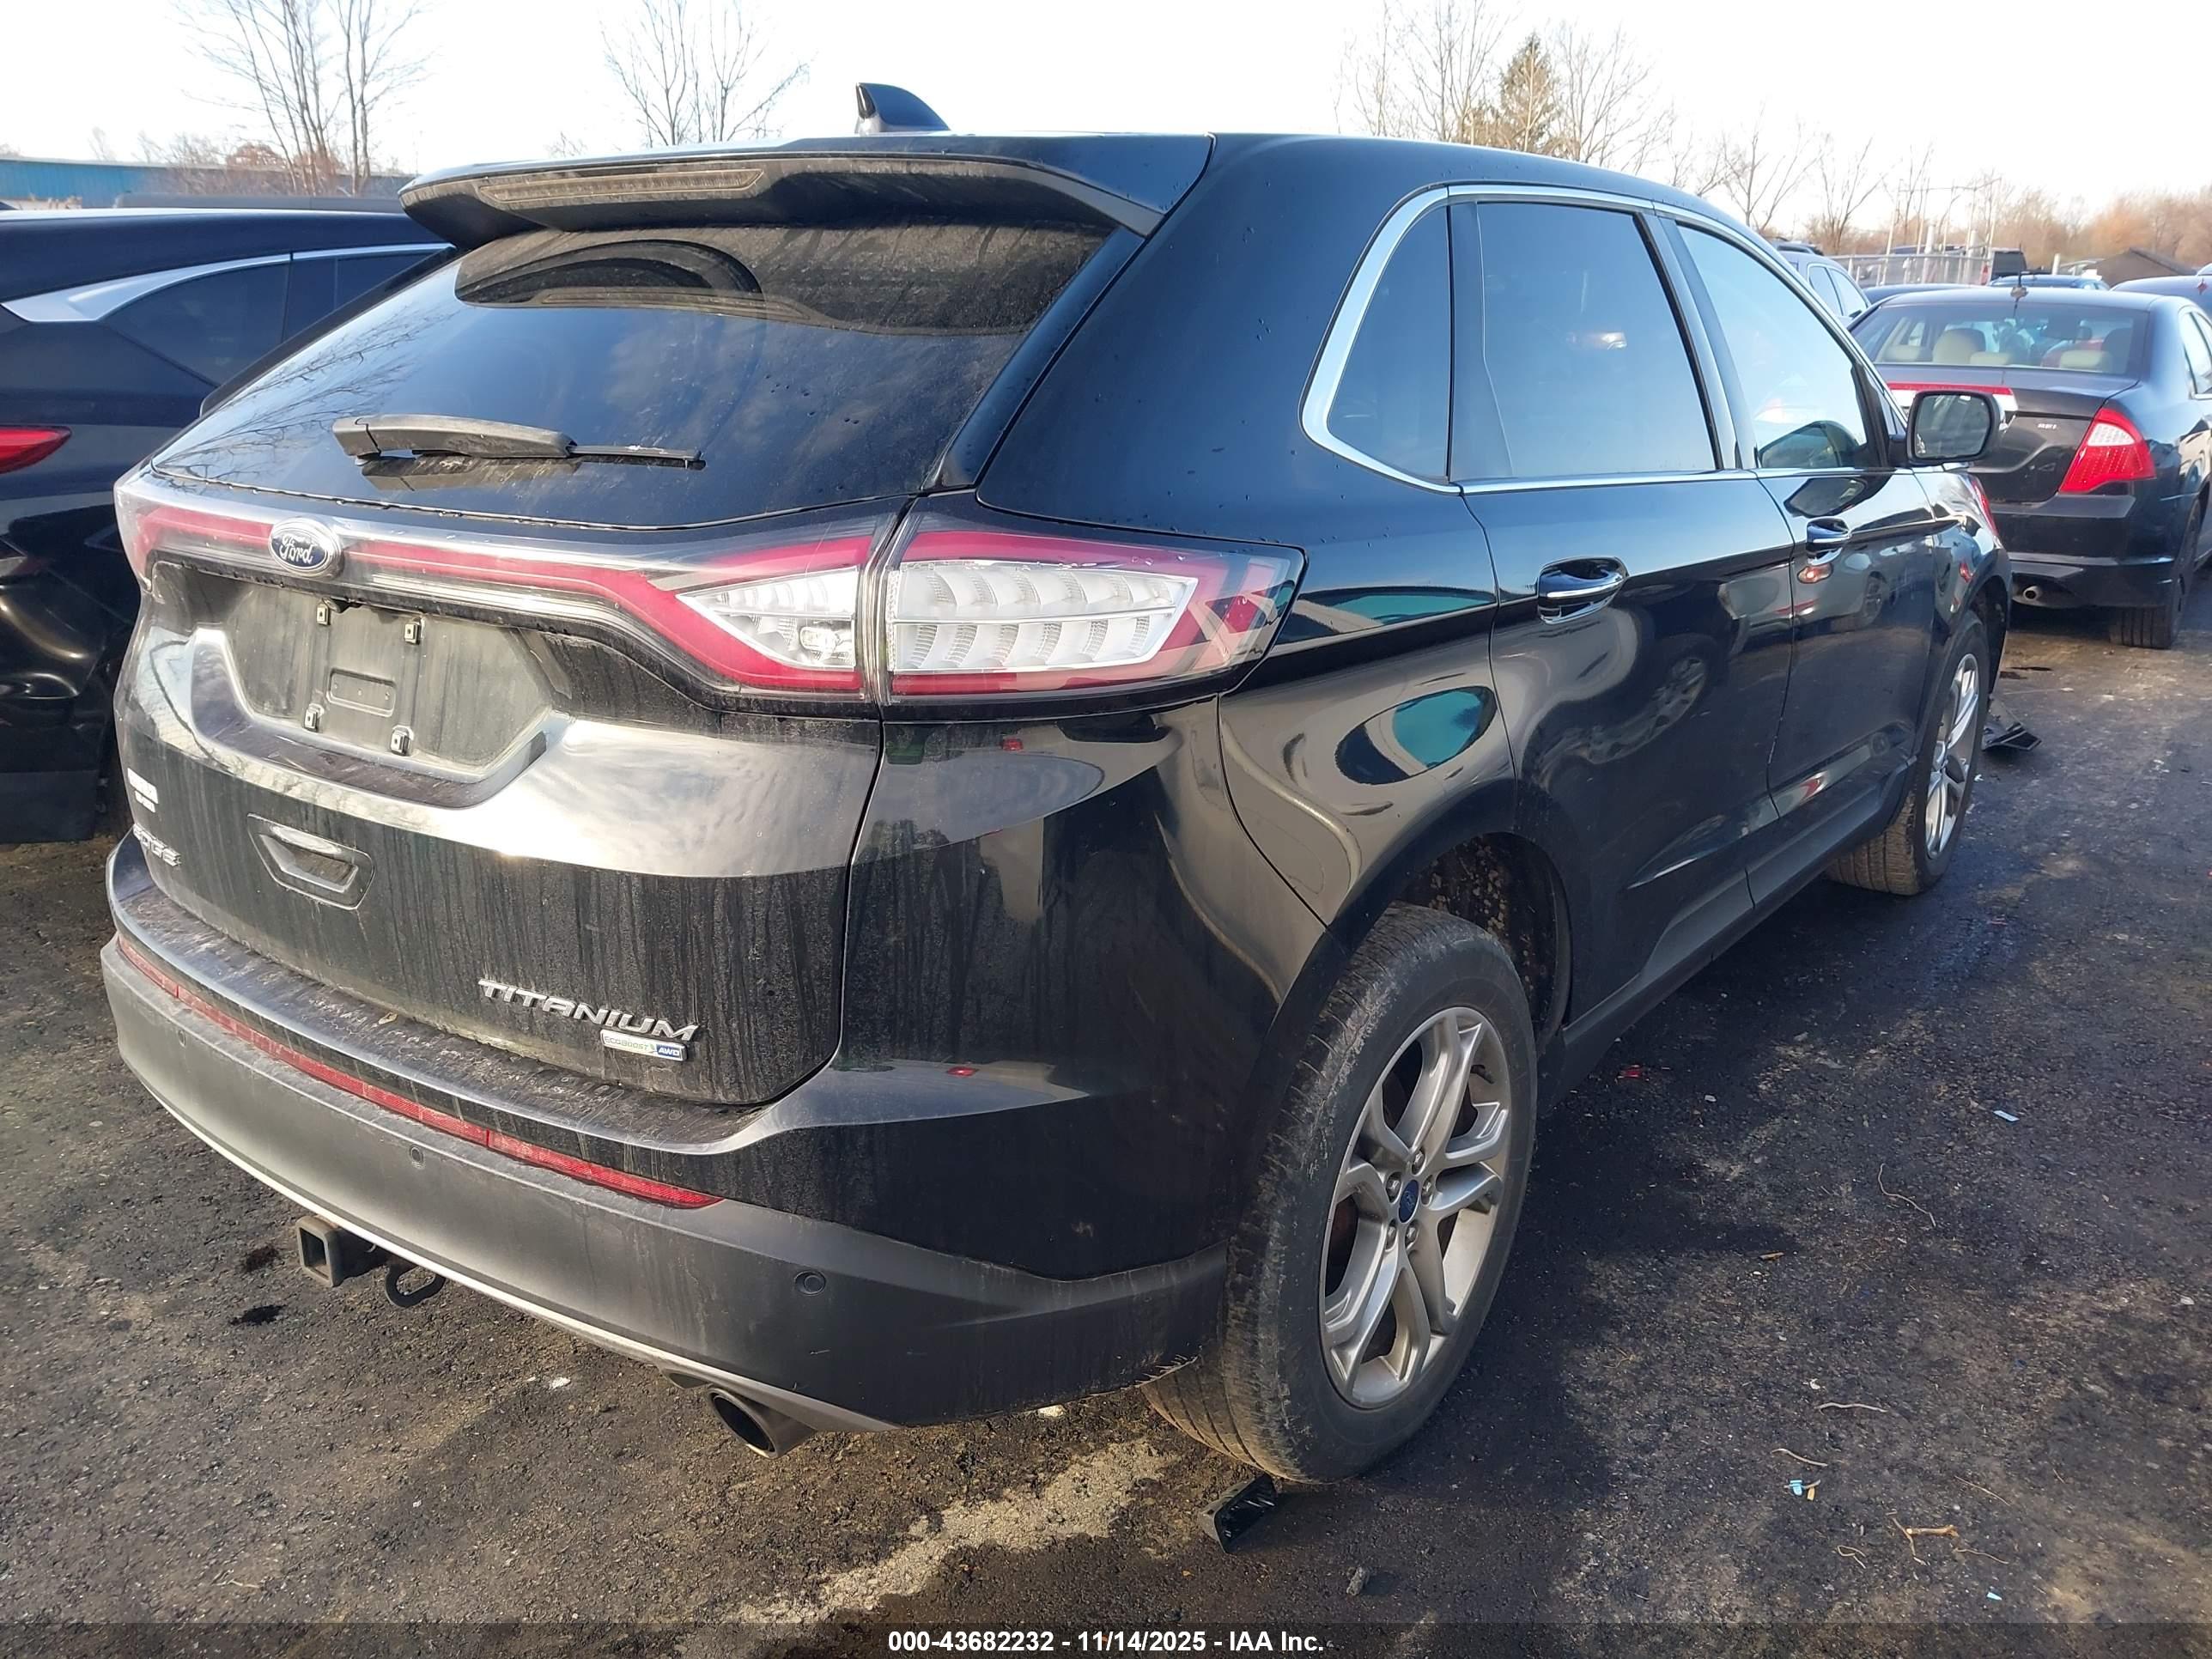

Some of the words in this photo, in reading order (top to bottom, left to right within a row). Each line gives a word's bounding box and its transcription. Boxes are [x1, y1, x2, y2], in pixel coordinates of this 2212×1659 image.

[279, 533, 315, 564] Ford
[133, 823, 182, 866] EDGE
[477, 978, 700, 1041] TITANIUM
[658, 1047, 680, 1056] AWD
